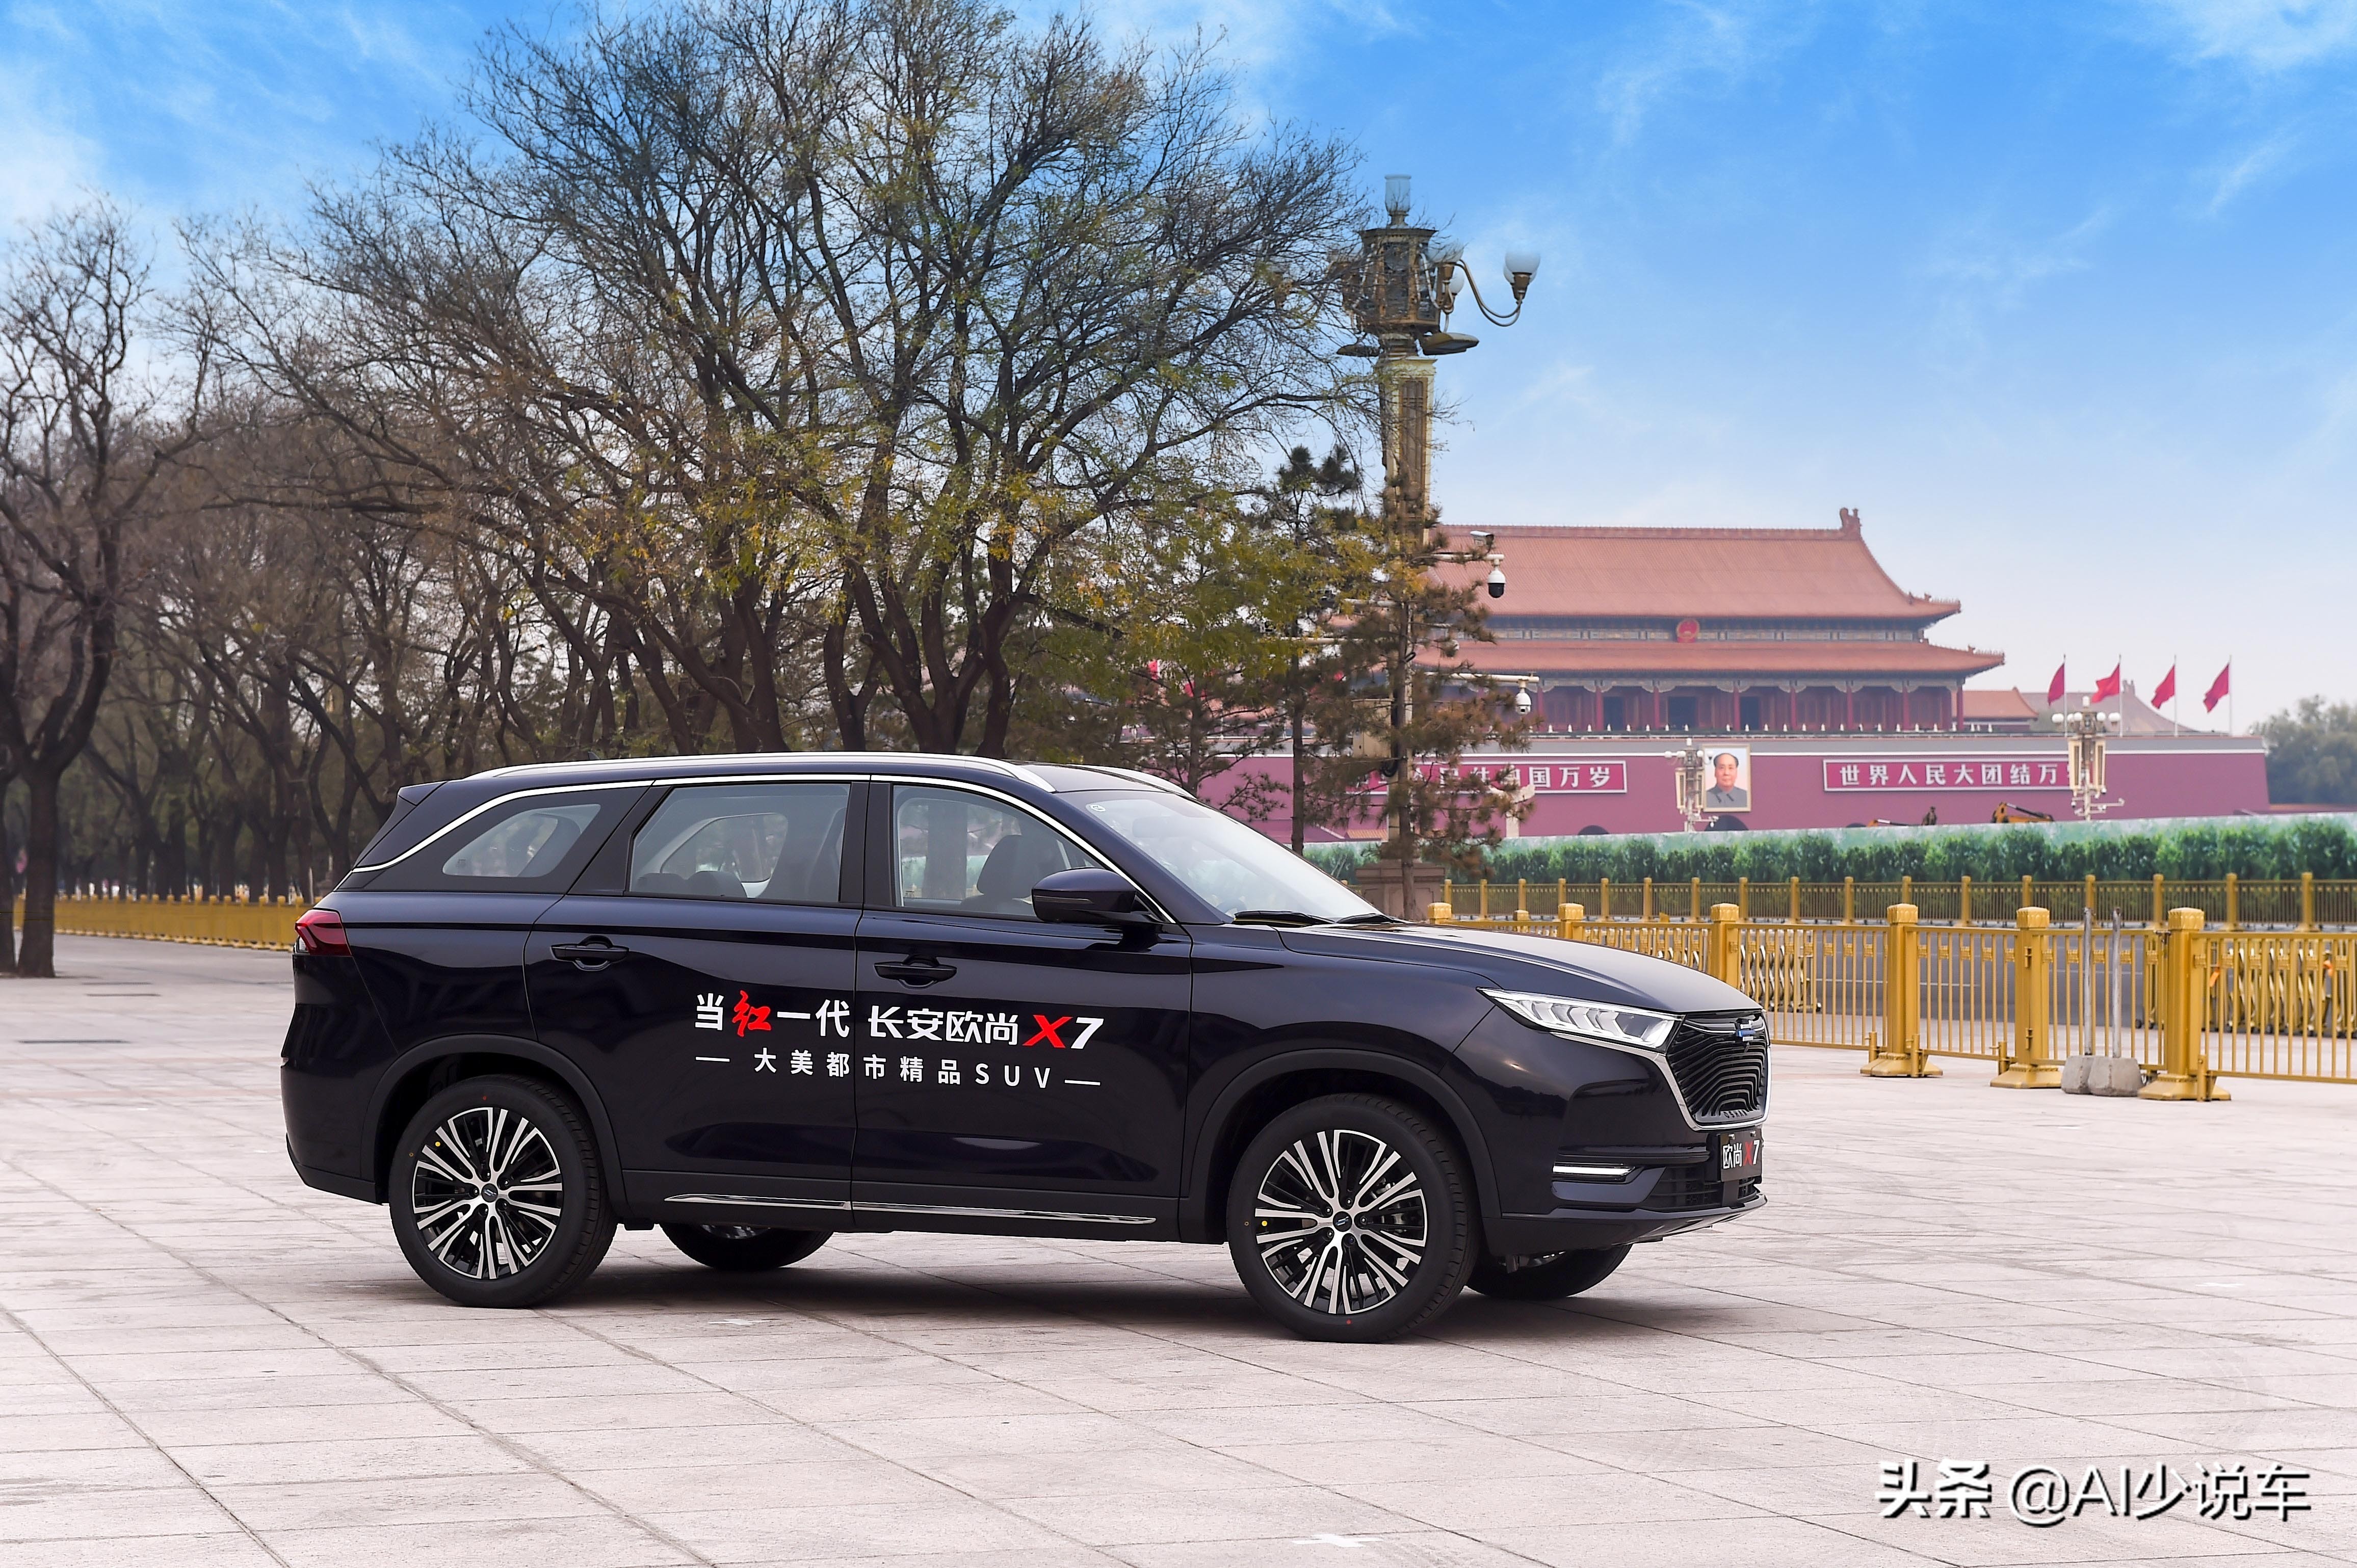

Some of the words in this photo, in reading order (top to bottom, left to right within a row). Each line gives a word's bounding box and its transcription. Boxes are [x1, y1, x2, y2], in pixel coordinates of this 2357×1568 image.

[1840, 763, 2087, 786] 世界人民大团结万
[694, 990, 850, 1038] 当红一代
[868, 1005, 1104, 1050] 长安欧尚X7
[1722, 1139, 1760, 1170] 欧尚X7
